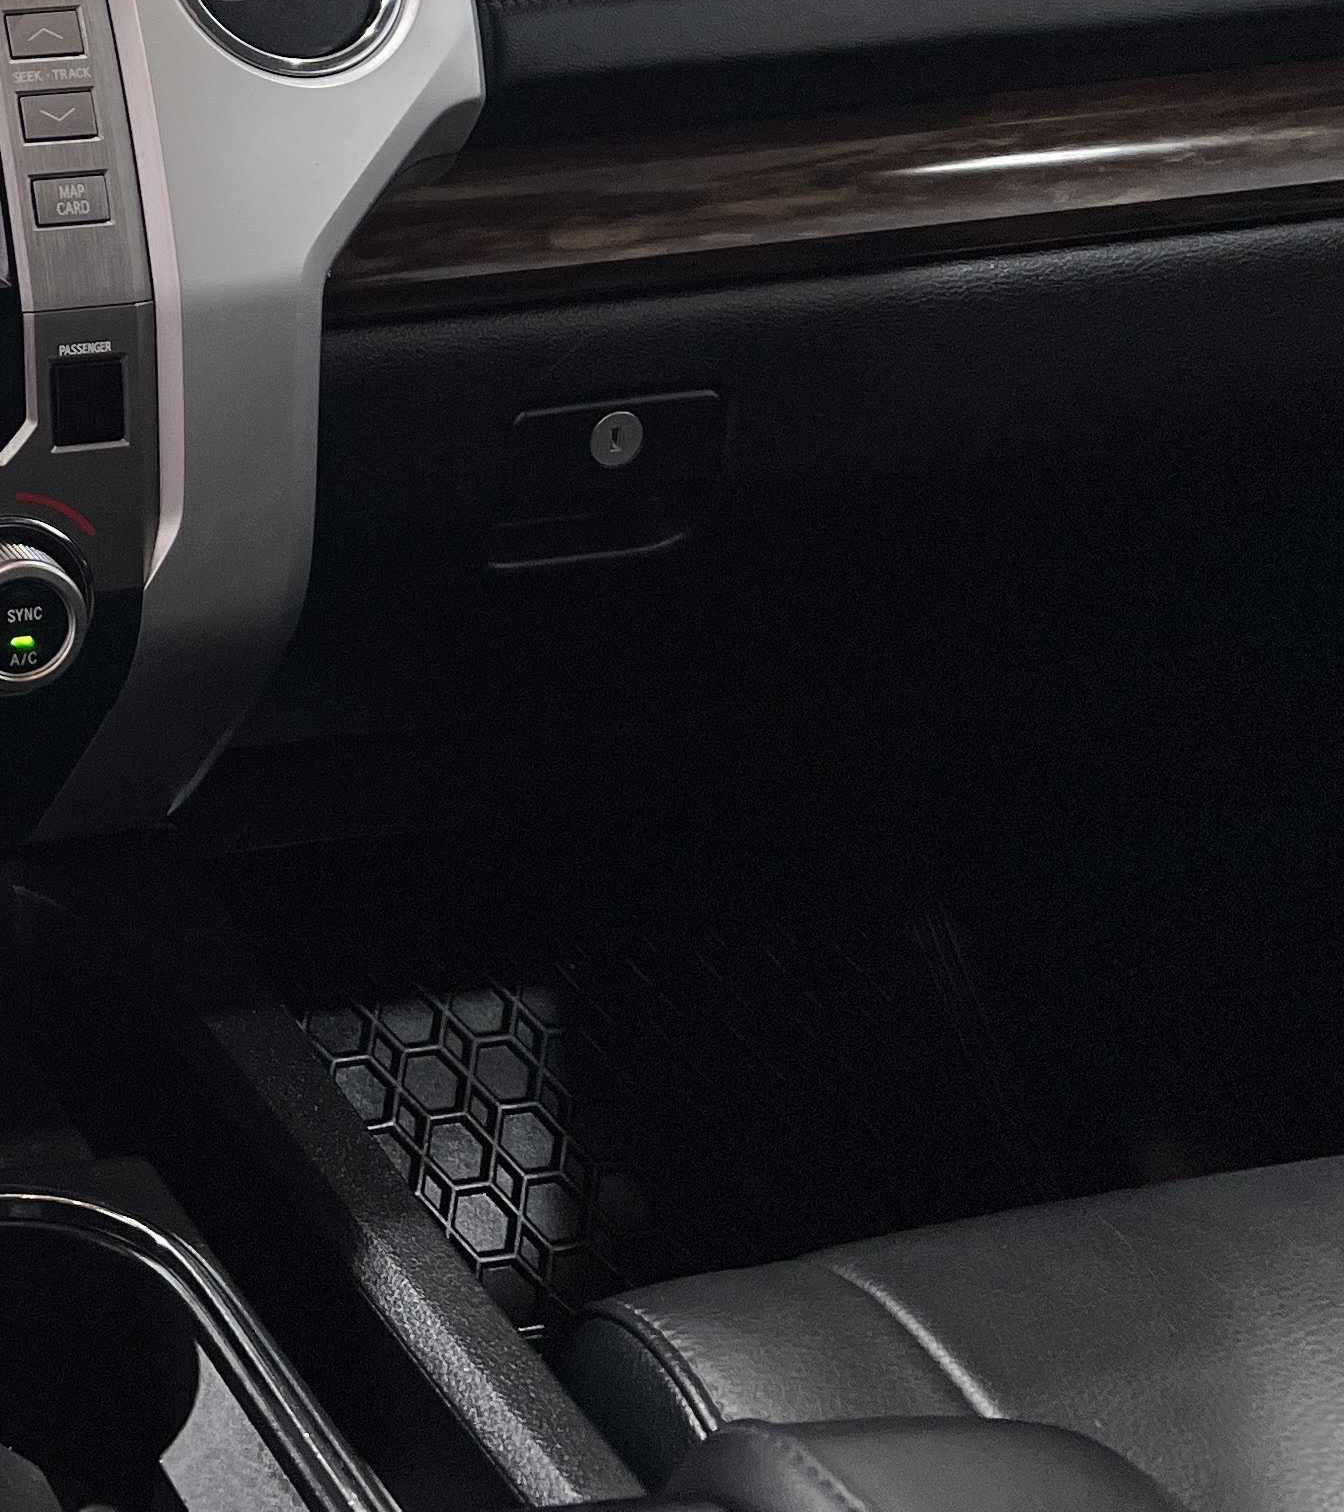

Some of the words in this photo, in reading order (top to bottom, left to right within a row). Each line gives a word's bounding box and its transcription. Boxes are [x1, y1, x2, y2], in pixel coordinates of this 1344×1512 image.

[58, 183, 85, 199] MAP
[56, 199, 90, 216] CARD
[58, 341, 112, 356] PASSENGER
[7, 606, 43, 624] SYNC
[9, 650, 38, 667] A/C
